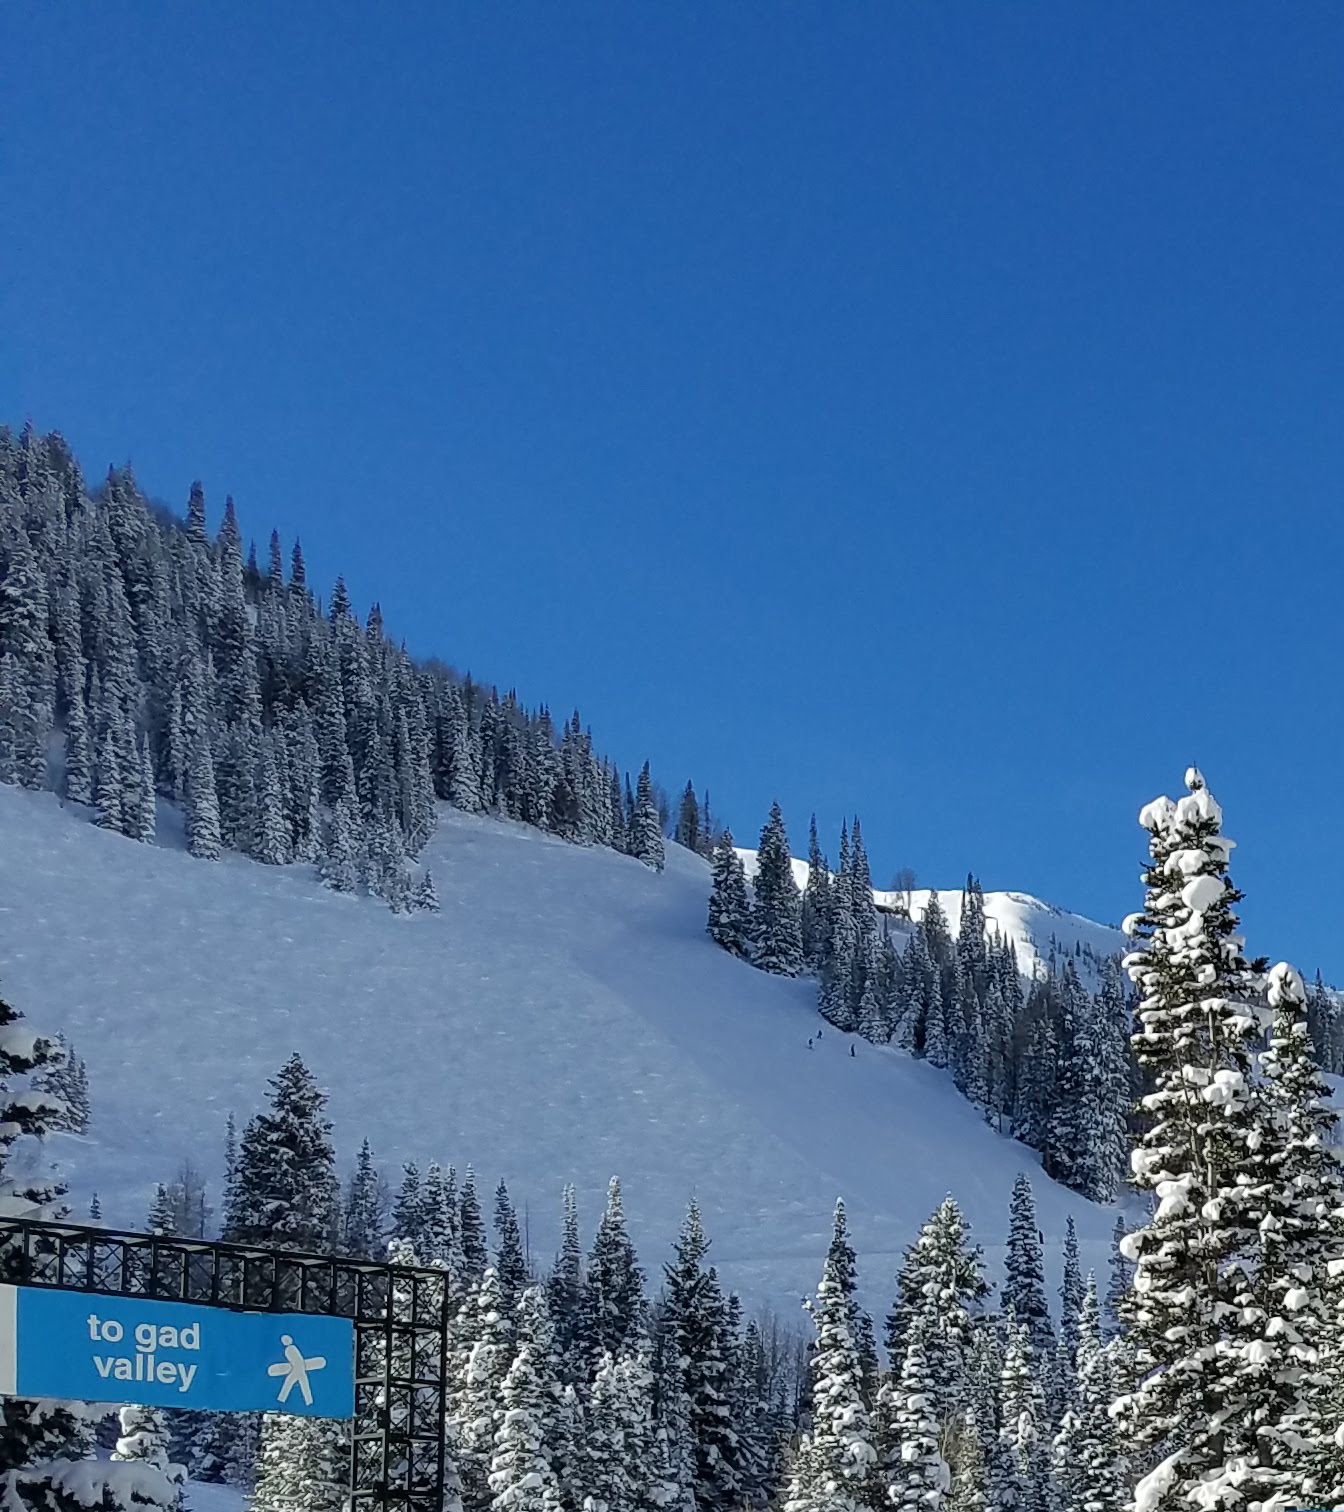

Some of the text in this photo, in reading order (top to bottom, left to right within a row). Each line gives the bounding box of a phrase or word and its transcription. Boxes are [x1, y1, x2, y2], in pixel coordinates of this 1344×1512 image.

[87, 1314, 200, 1351] to gad
[93, 1354, 198, 1392] valley
